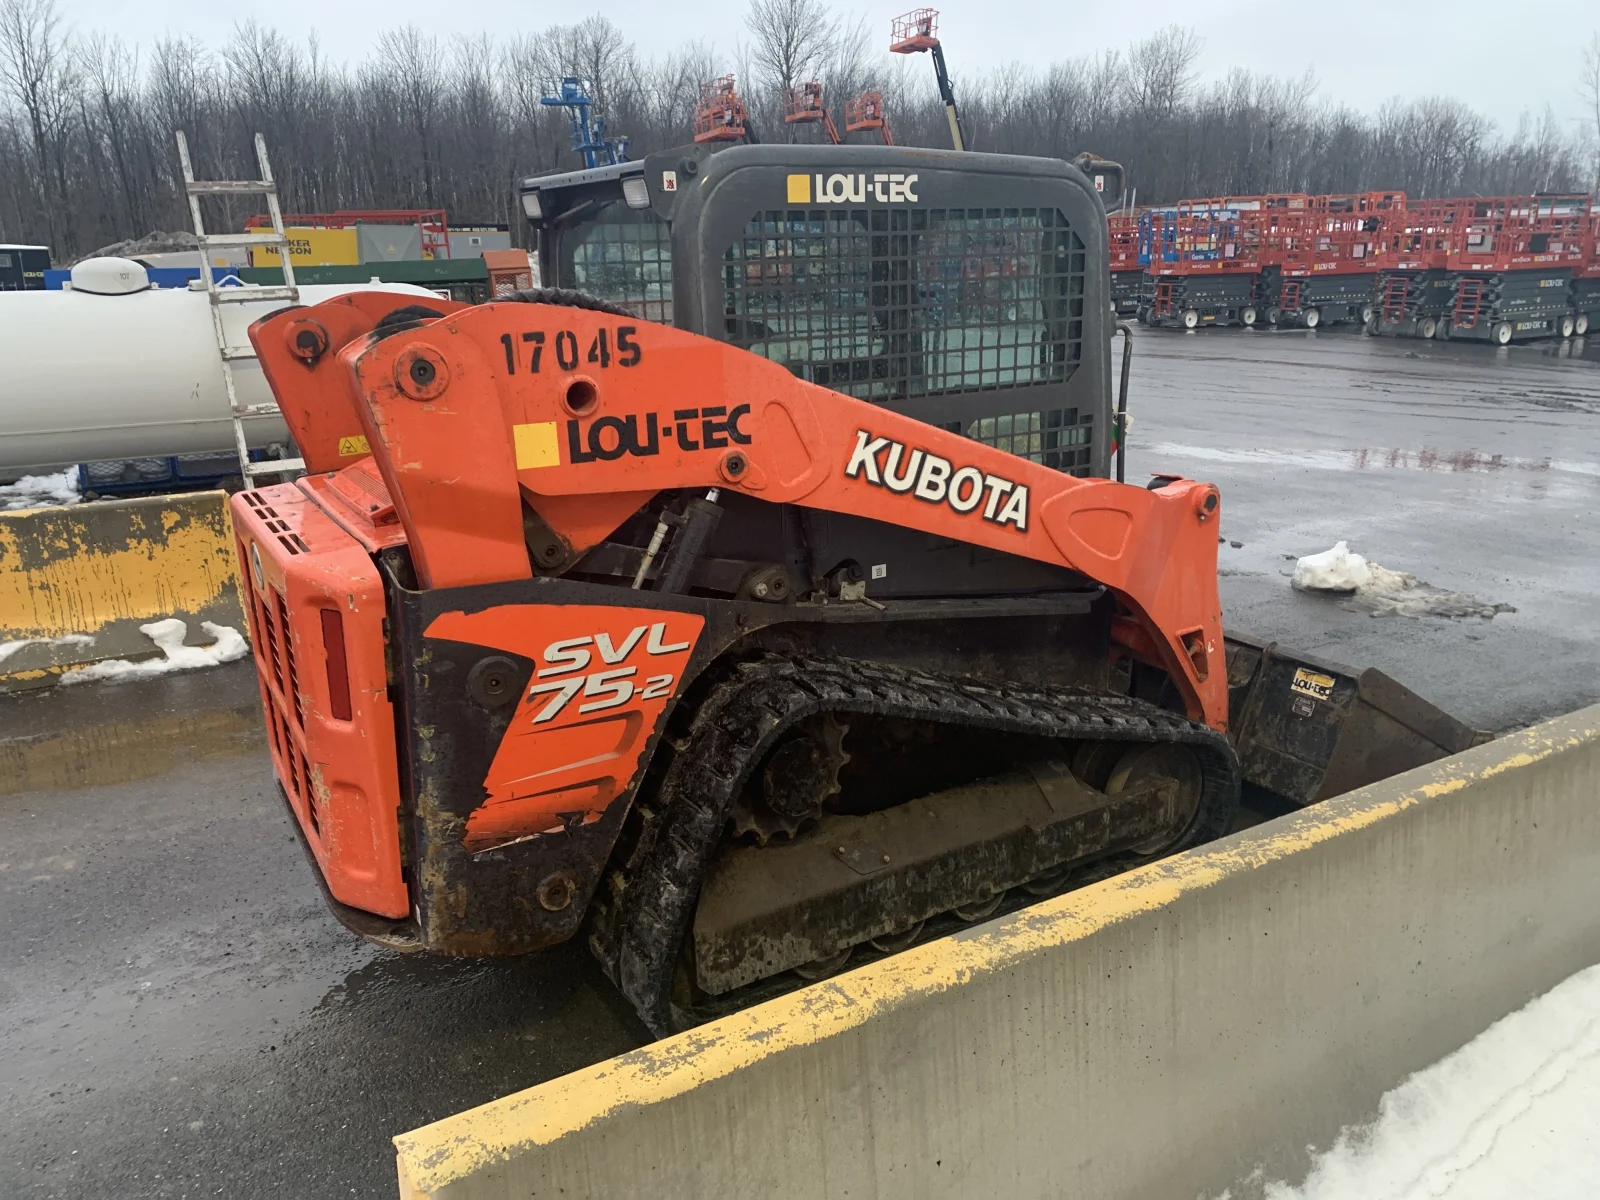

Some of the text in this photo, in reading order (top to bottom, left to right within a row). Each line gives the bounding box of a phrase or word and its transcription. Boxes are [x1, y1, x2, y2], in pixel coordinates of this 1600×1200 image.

[815, 173, 919, 203] LOU-TEC
[265, 246, 312, 256] NESON
[501, 326, 642, 375] 17045
[567, 403, 752, 464] LOU-TEC
[845, 429, 1030, 533] KUBOTA
[537, 622, 690, 679] SVL
[529, 665, 674, 724] 75-2
